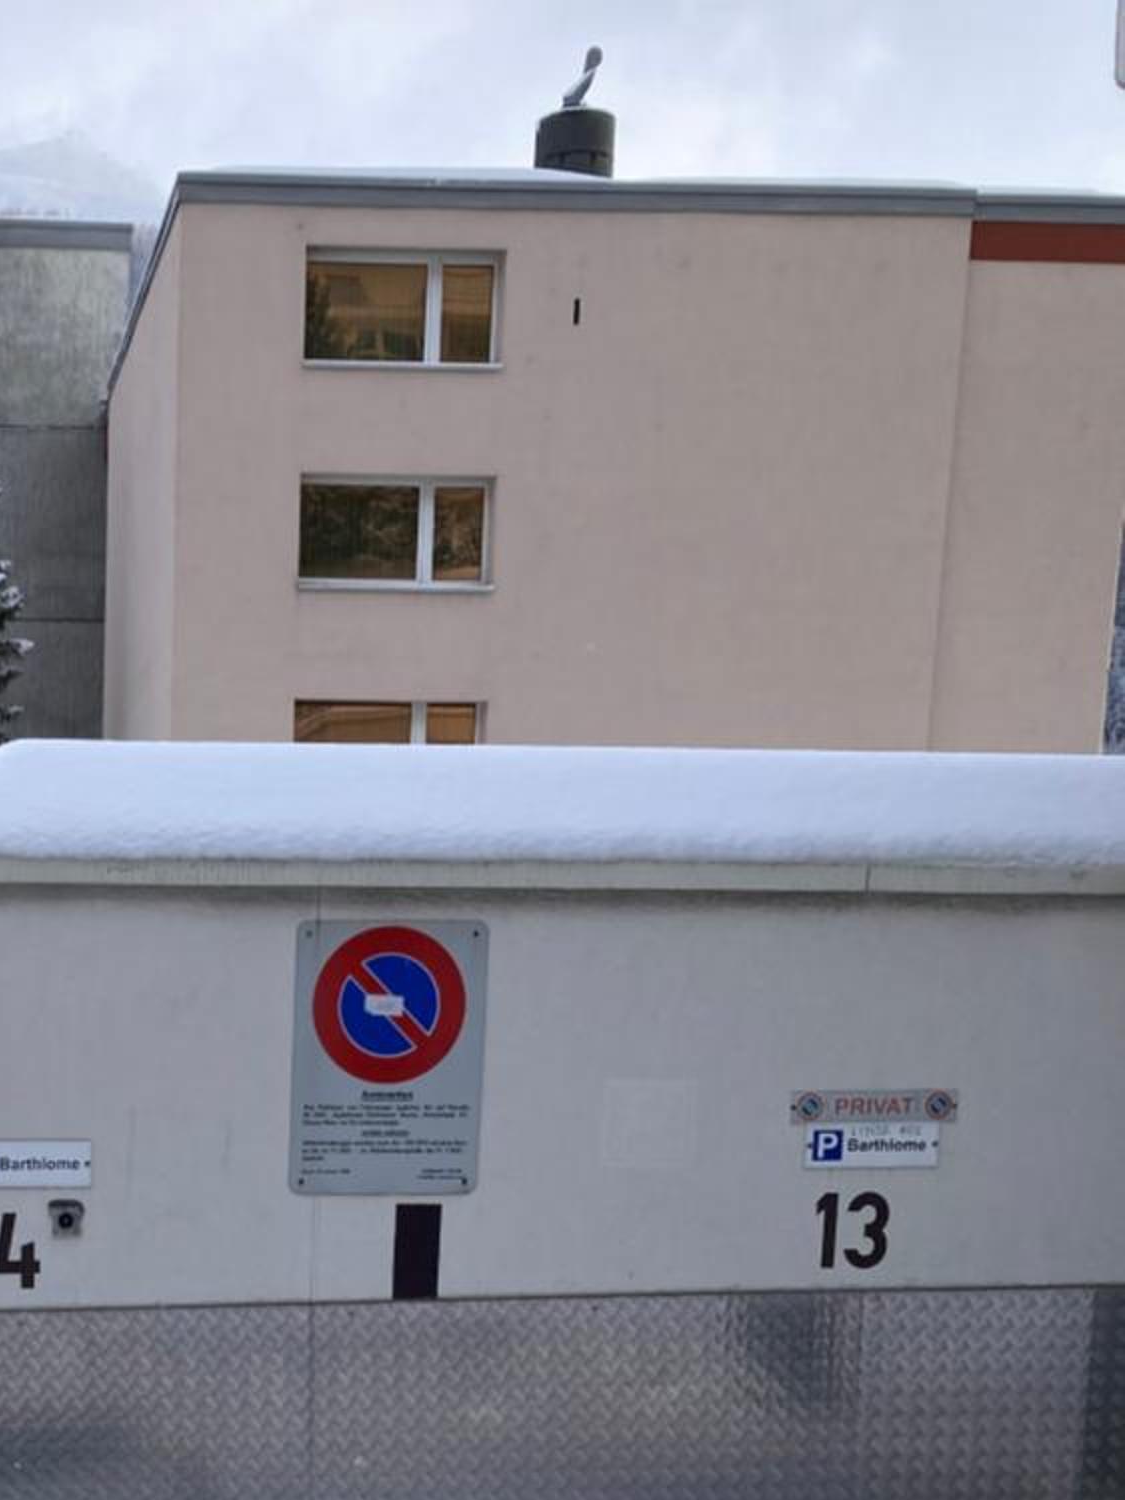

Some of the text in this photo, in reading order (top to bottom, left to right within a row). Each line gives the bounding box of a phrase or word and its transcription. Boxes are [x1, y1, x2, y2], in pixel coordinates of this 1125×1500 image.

[835, 1097, 914, 1114] PRIVAT
[817, 1133, 839, 1159] P
[815, 1190, 891, 1269] 13
